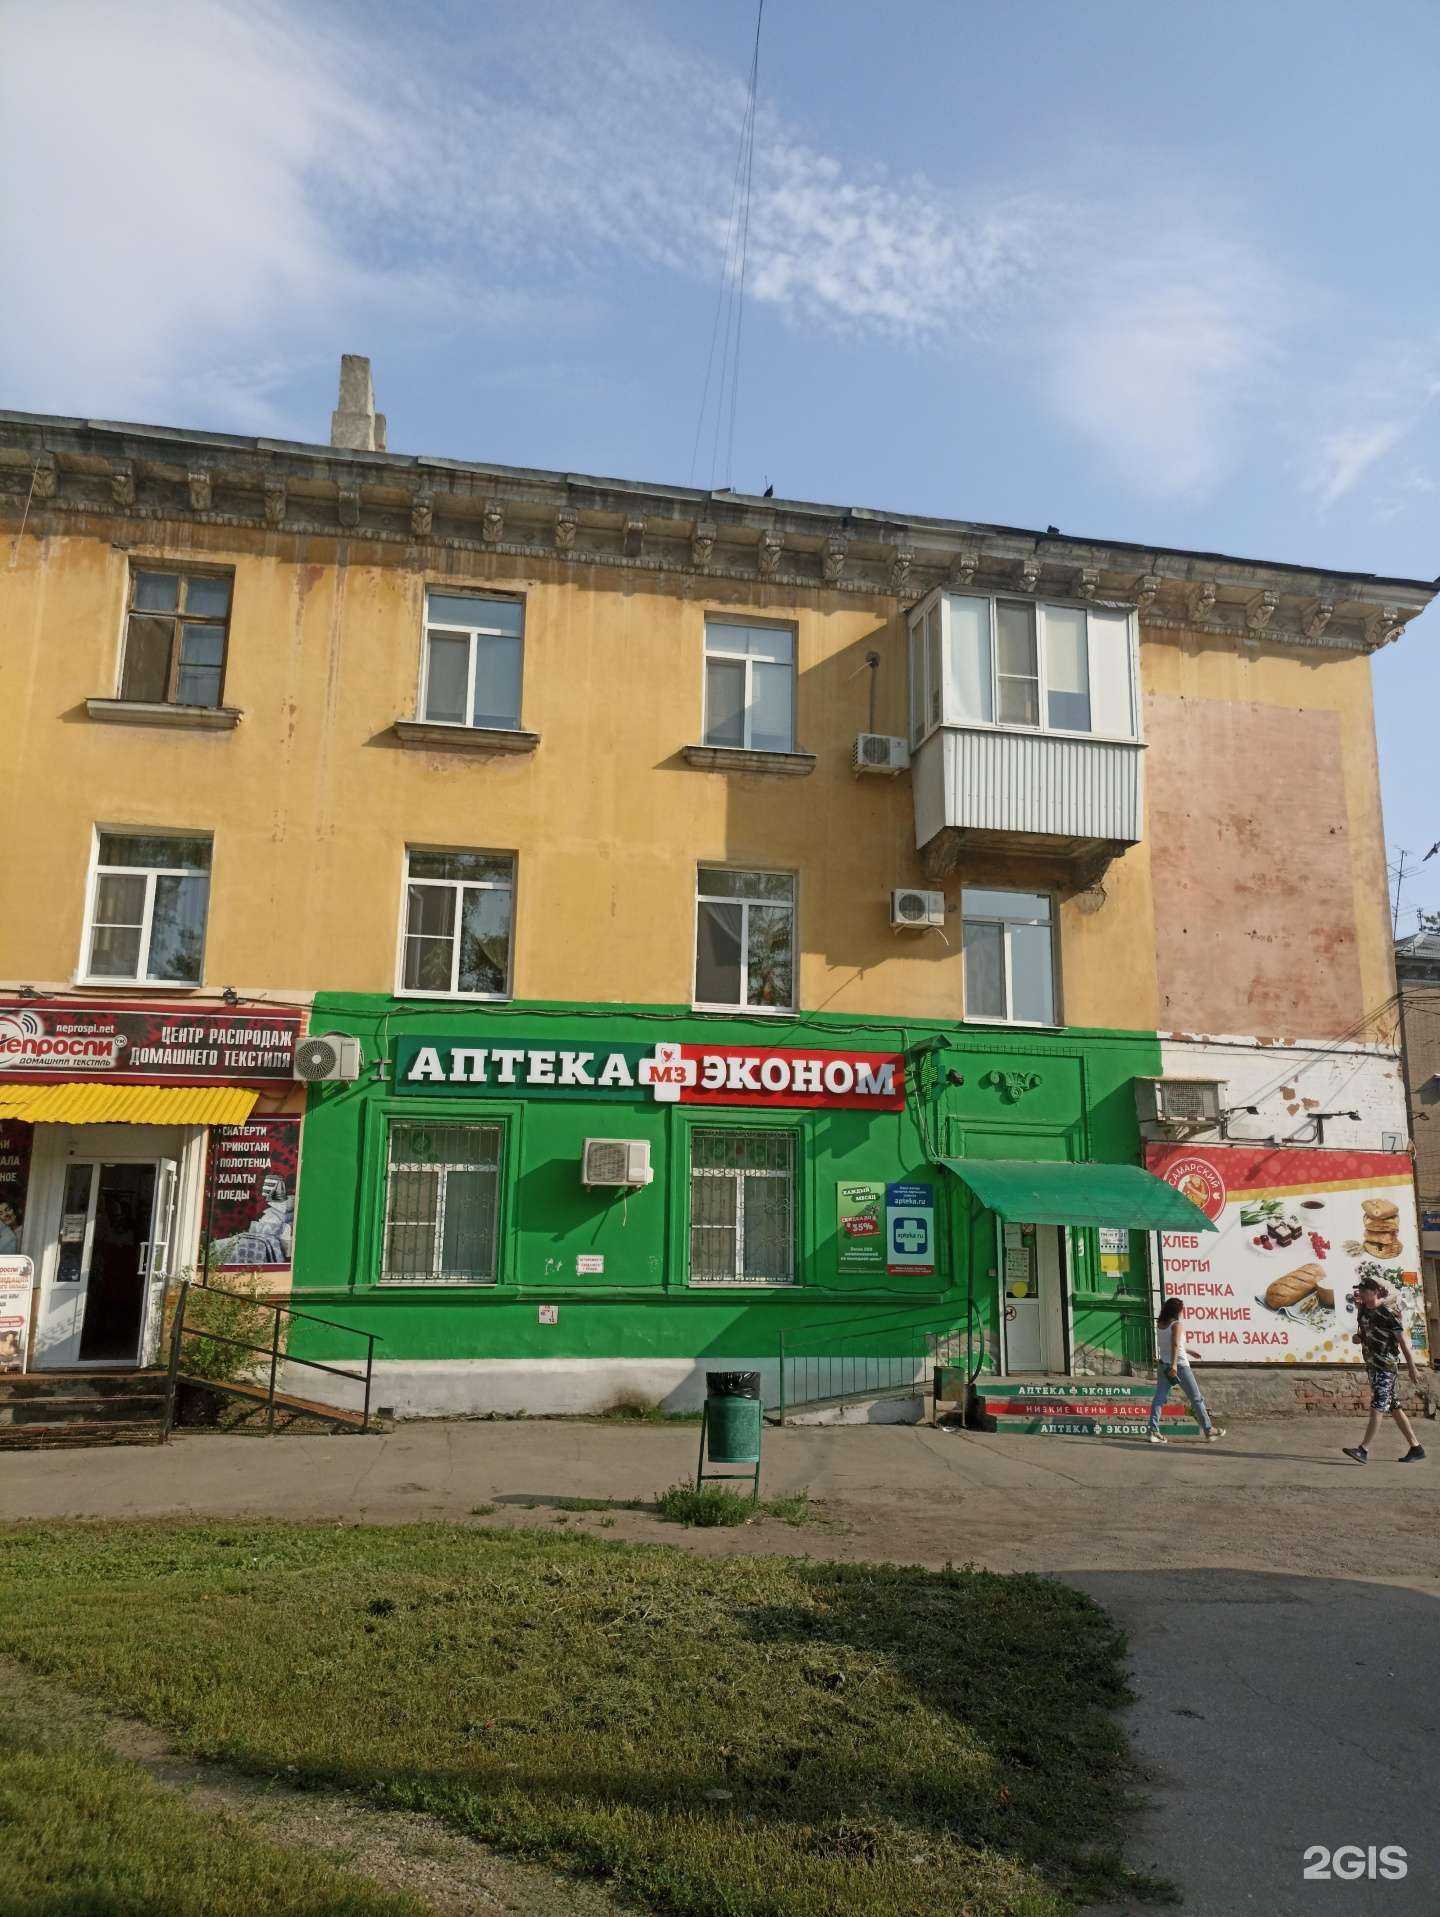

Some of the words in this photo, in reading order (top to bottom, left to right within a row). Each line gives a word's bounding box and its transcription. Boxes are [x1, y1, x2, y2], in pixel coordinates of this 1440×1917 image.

[161, 1026, 203, 1045] ЦЕНТР
[209, 1028, 293, 1048] РАСПРОДАЖ
[72, 1058, 111, 1066] ТЕКСТИЛЬ
[129, 1047, 217, 1066] ДОМАШНЕГО
[224, 1050, 290, 1068] ТЕКСТИЛЯ
[408, 1047, 634, 1087] АПТЕКА
[701, 1055, 895, 1095] ЭКОНОМ
[222, 1126, 267, 1136] СКАТЕРТИ
[221, 1142, 270, 1152] ТРИКОТАЖ
[1388, 1136, 1396, 1151] 7
[220, 1158, 271, 1169] ПОЛОТЕНЦА
[218, 1174, 256, 1184] ХАЛАТЫ
[1169, 1163, 1220, 1188] САМАРСКИЙ
[217, 1190, 250, 1201] ПЛЕДЫ
[1162, 1235, 1199, 1248] ХЛЕБ
[1164, 1259, 1210, 1272] ТОРТЫ
[1165, 1283, 1234, 1296] ВЫПЕЧКА
[1182, 1307, 1251, 1320] РОЖНЫЕ
[1186, 1331, 1214, 1343] РТЫ
[1219, 1332, 1242, 1344] НА
[1243, 1331, 1288, 1344] ЗАКАЗ
[1018, 1387, 1066, 1395] АПТЕКА
[1081, 1387, 1131, 1395] ЭКОНОМ
[1026, 1405, 1071, 1414] НИЗКИЕ
[1076, 1406, 1107, 1414] ЦЕНЫ
[1113, 1406, 1147, 1414] ЗДЕСЬ
[1040, 1424, 1089, 1434] АПТЕКА
[1106, 1425, 1151, 1434] ЭКОНО
